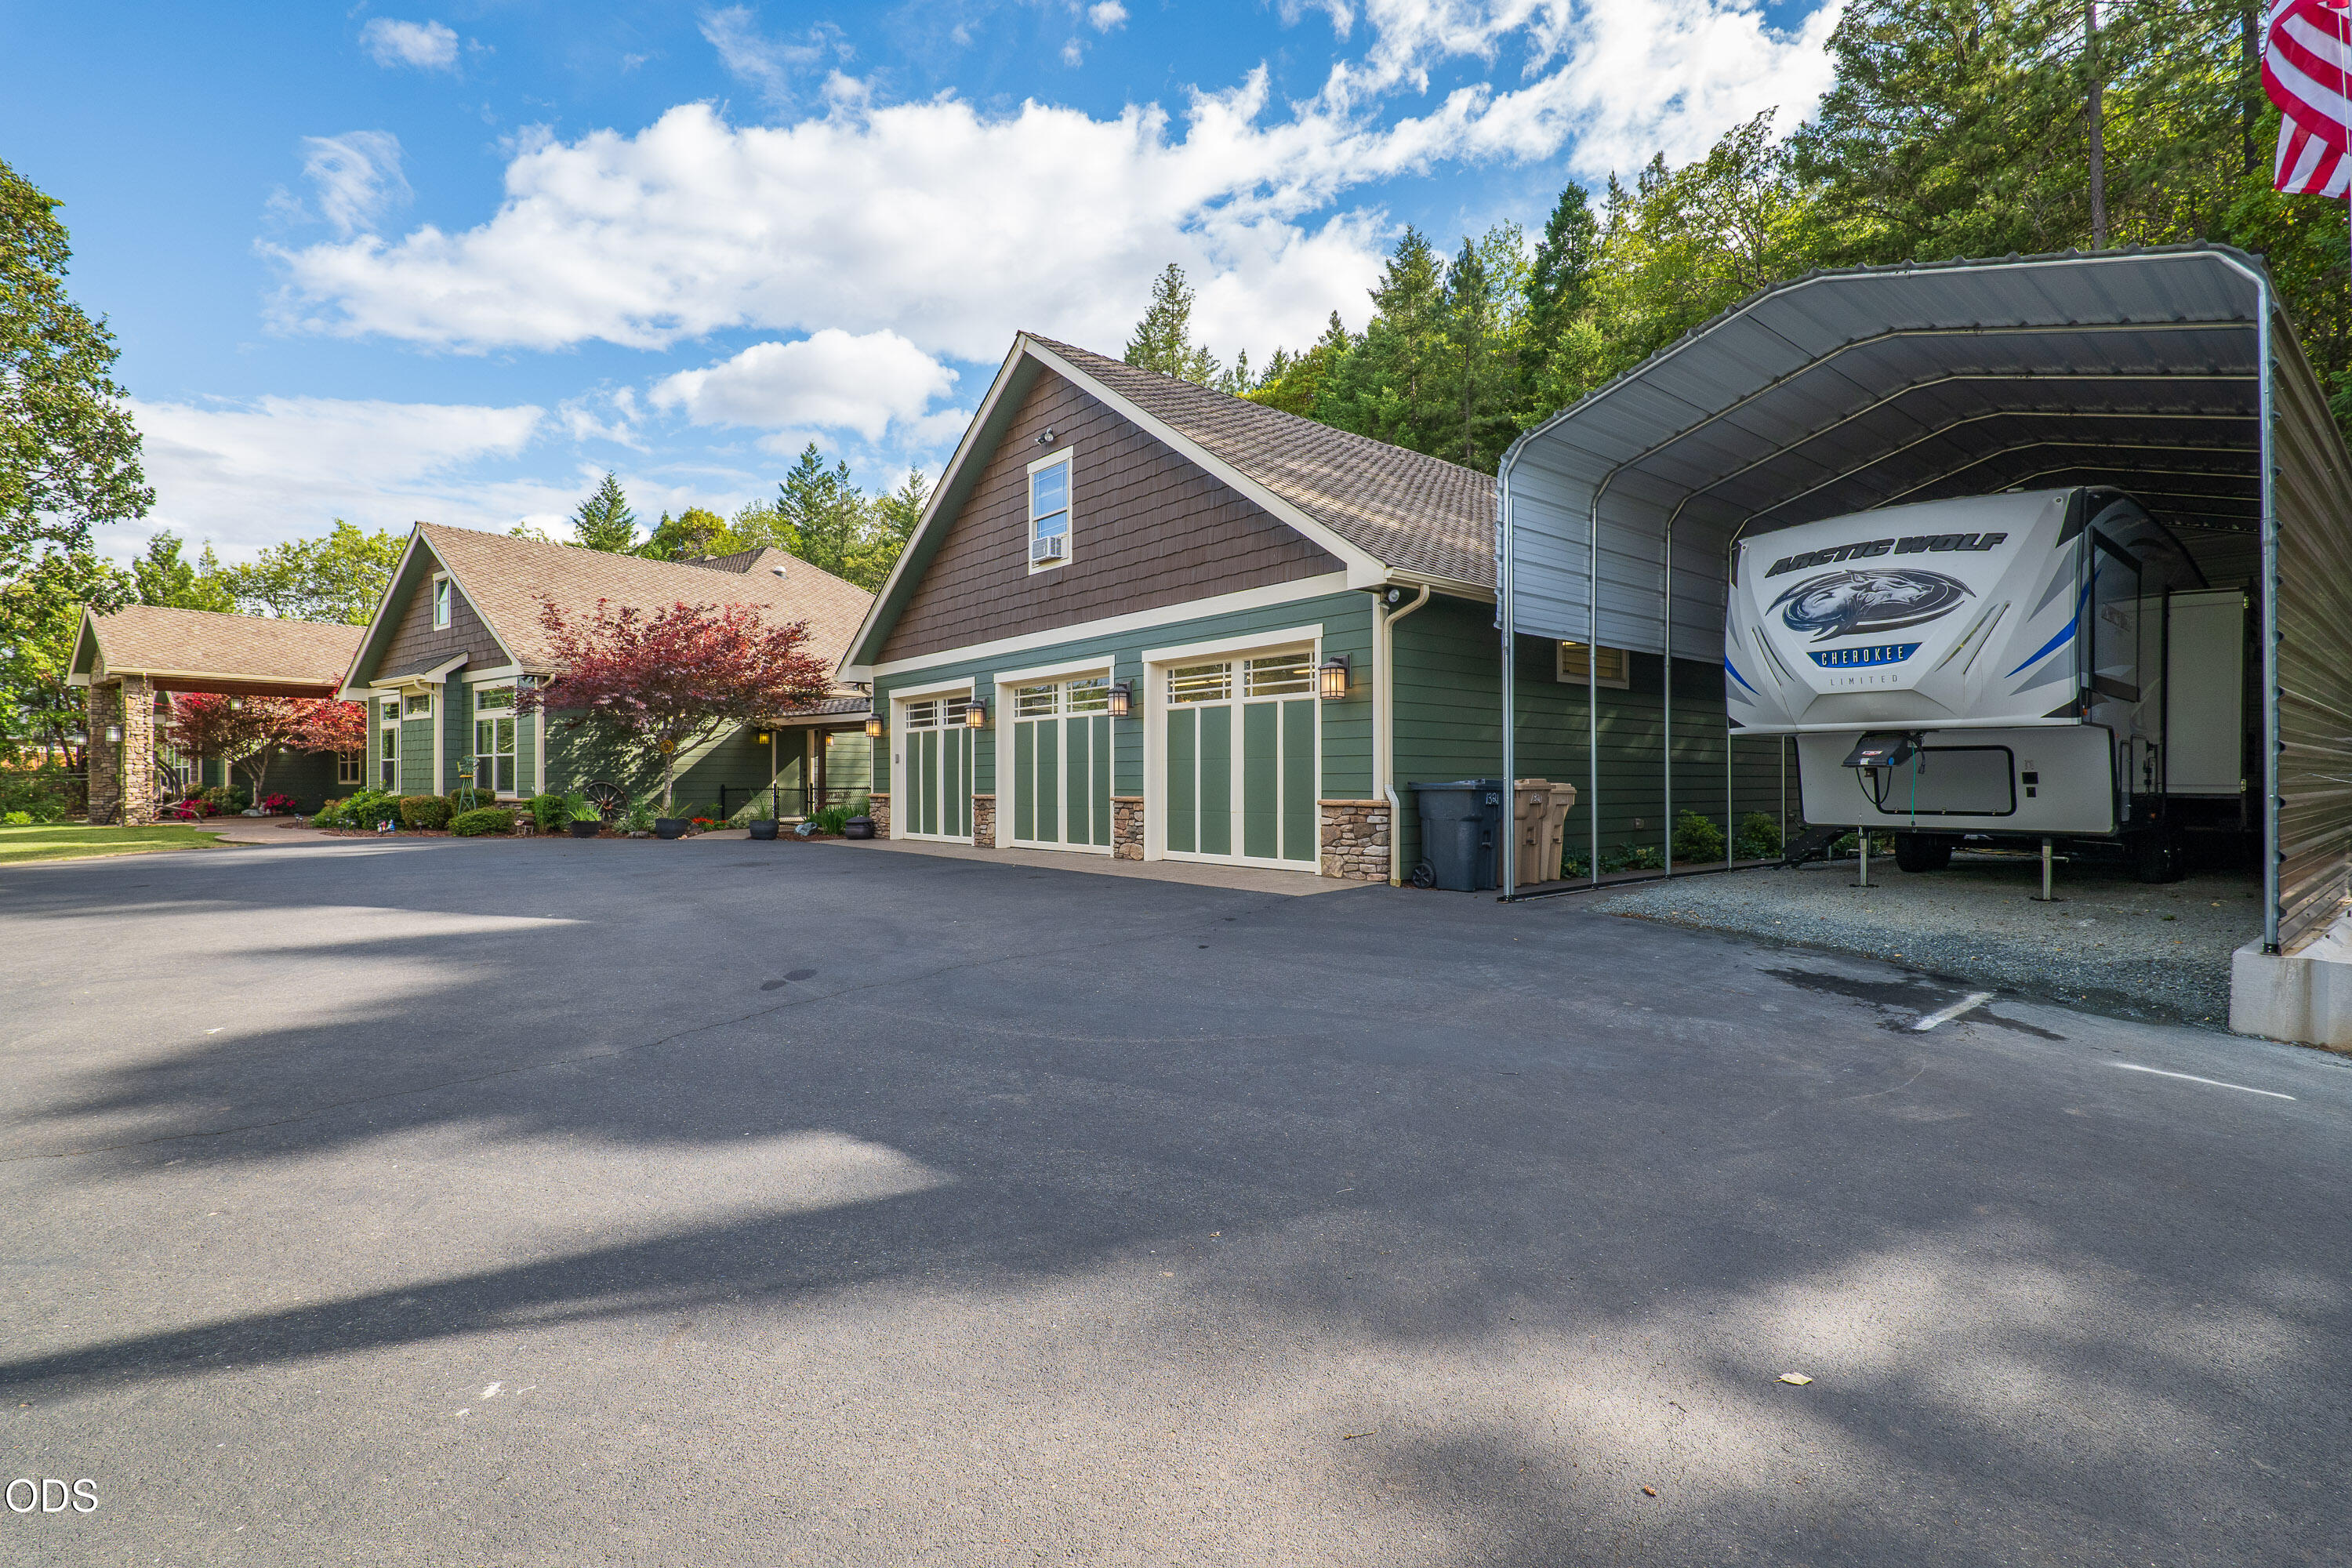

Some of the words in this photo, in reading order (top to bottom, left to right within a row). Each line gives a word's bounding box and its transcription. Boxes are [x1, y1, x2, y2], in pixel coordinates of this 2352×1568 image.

[1765, 539, 1895, 578] ARCTIC
[1894, 532, 2009, 554] WOLF
[1821, 646, 1904, 666] CHEROKEE
[1830, 674, 1897, 686] LIMITED
